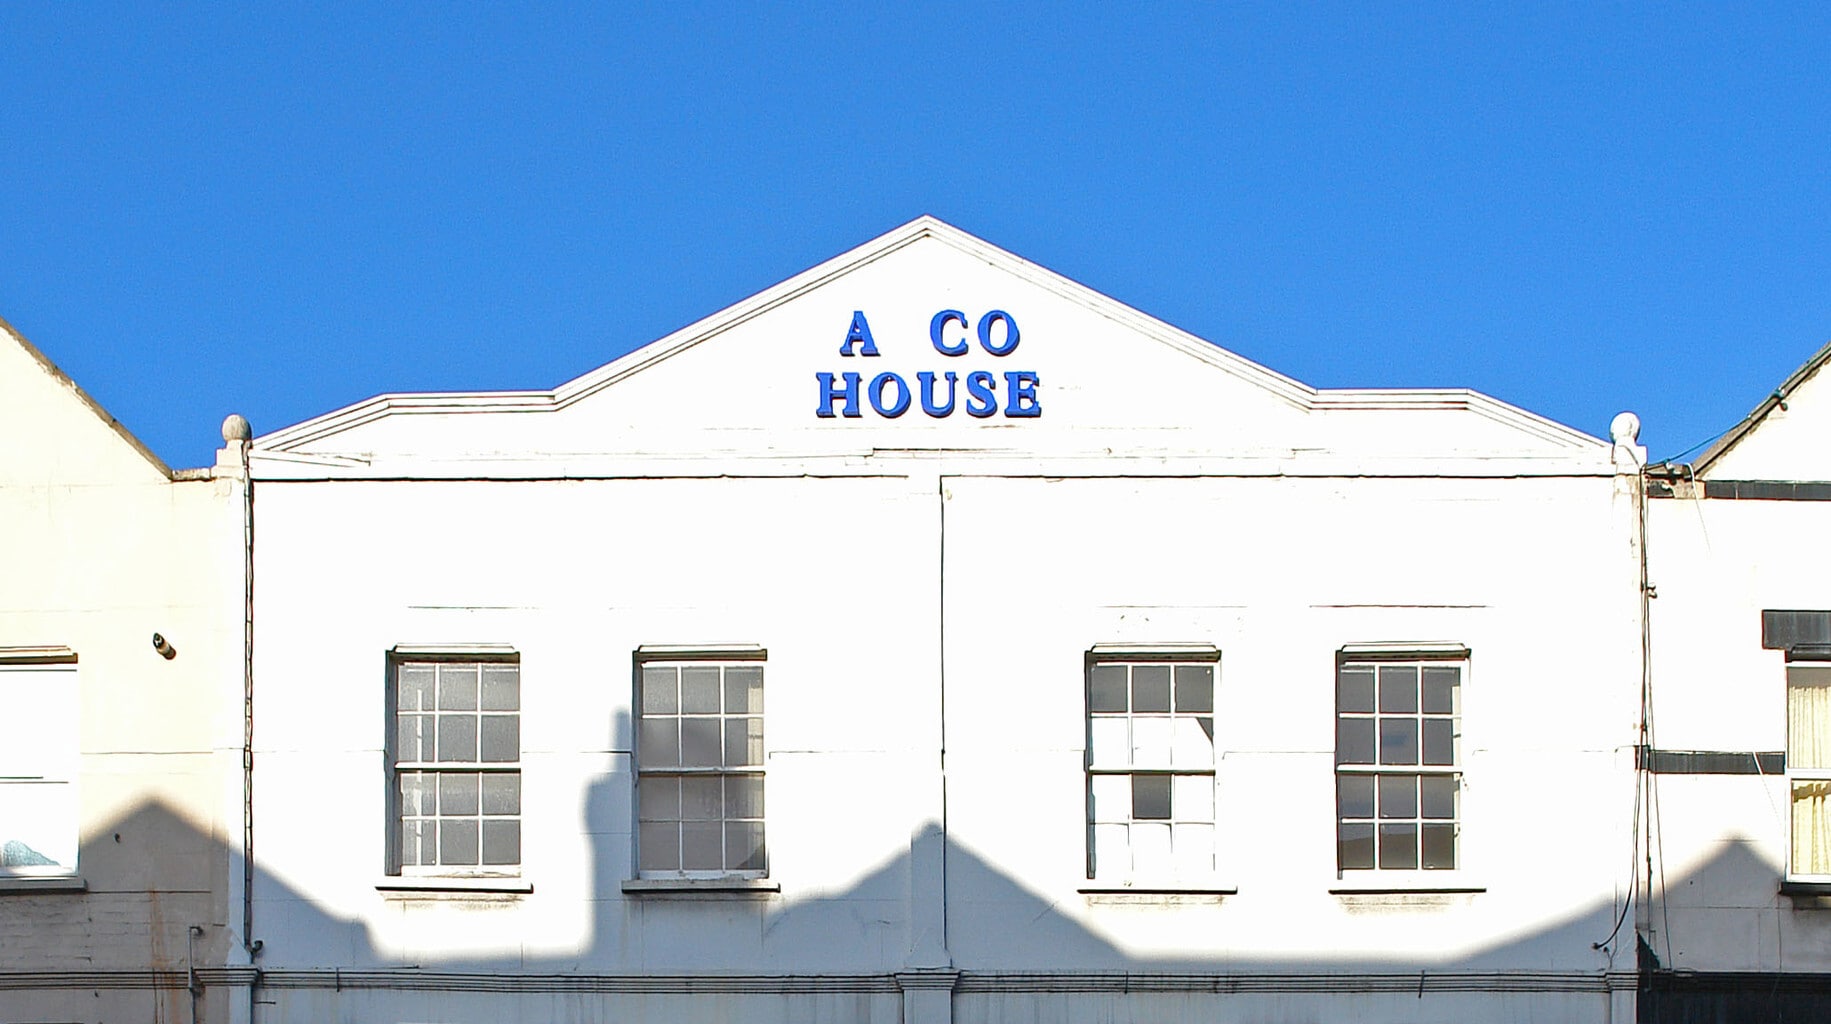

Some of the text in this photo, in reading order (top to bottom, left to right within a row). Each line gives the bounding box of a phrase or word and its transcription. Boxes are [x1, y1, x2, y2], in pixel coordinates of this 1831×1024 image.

[839, 309, 1021, 357] A CO
[816, 371, 1042, 418] HOUSE
